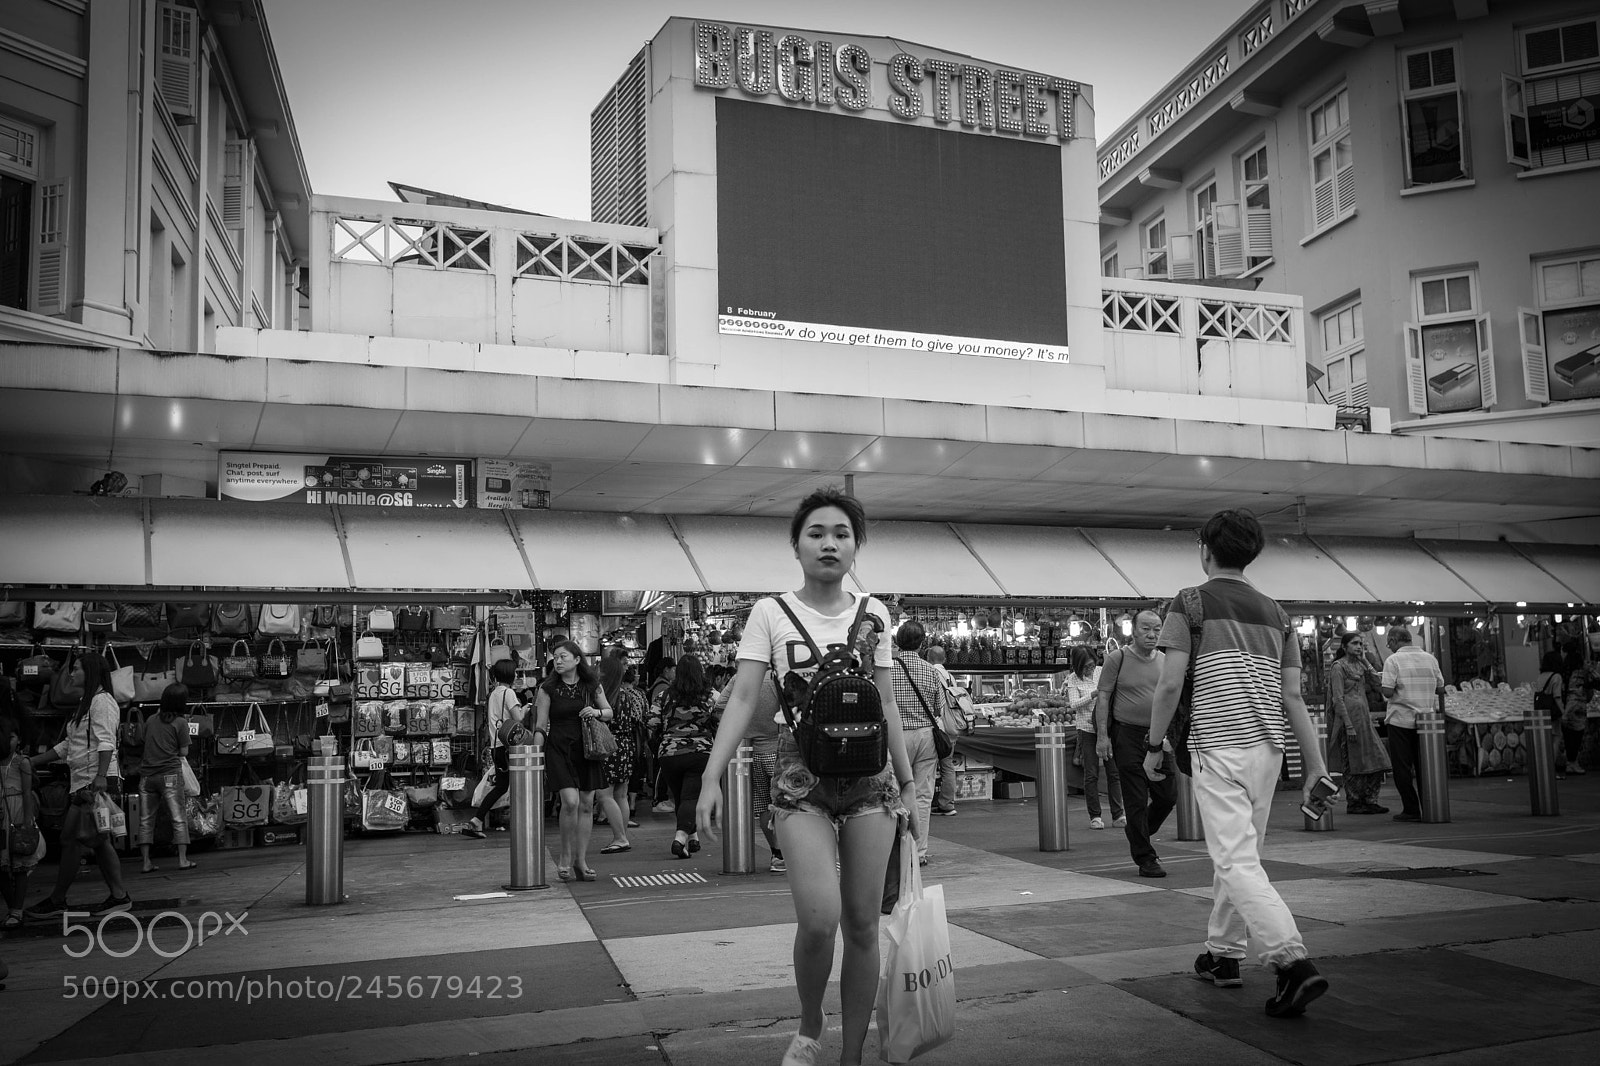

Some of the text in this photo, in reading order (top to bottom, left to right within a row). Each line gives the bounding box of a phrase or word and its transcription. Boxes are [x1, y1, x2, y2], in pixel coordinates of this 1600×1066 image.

[694, 21, 1080, 139] BUGIS STREET
[727, 306, 777, 319] 8 February
[799, 327, 816, 339] do
[820, 331, 845, 343] you
[849, 333, 870, 346] get
[874, 333, 907, 346] them
[911, 337, 923, 348] to
[927, 339, 953, 352] give
[957, 342, 980, 355] you
[984, 344, 1034, 360] money?
[1037, 348, 1054, 360] It's
[226, 461, 251, 470] Singtel
[226, 477, 255, 485] anytime
[306, 490, 413, 507] Hi Mobile@SG
[485, 494, 513, 502] Available
[380, 681, 401, 695] SG
[430, 684, 453, 698] SG
[409, 719, 428, 732] SG
[234, 787, 243, 802] I
[232, 803, 262, 819] SG
